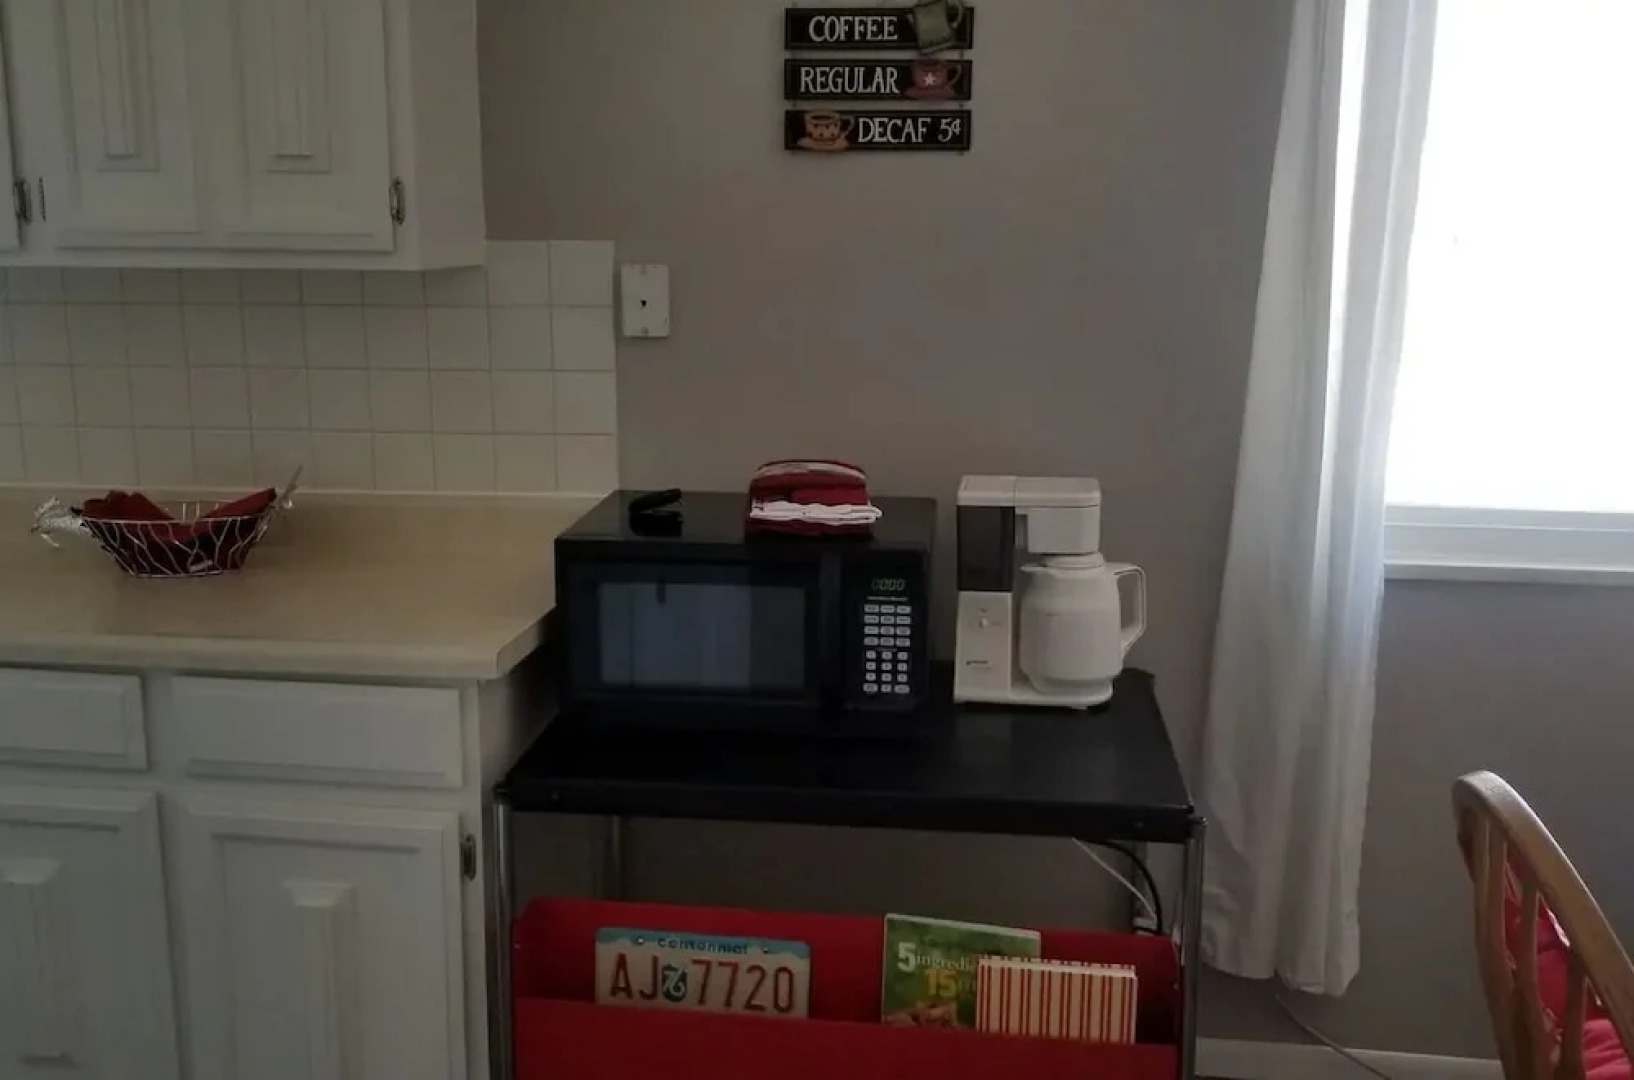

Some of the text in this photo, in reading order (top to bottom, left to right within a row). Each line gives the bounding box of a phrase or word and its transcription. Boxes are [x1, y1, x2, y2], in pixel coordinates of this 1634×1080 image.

[808, 15, 898, 42] COFFEE
[800, 66, 900, 94] REGULAR
[857, 117, 931, 143] DECAF
[925, 968, 957, 998] 15
